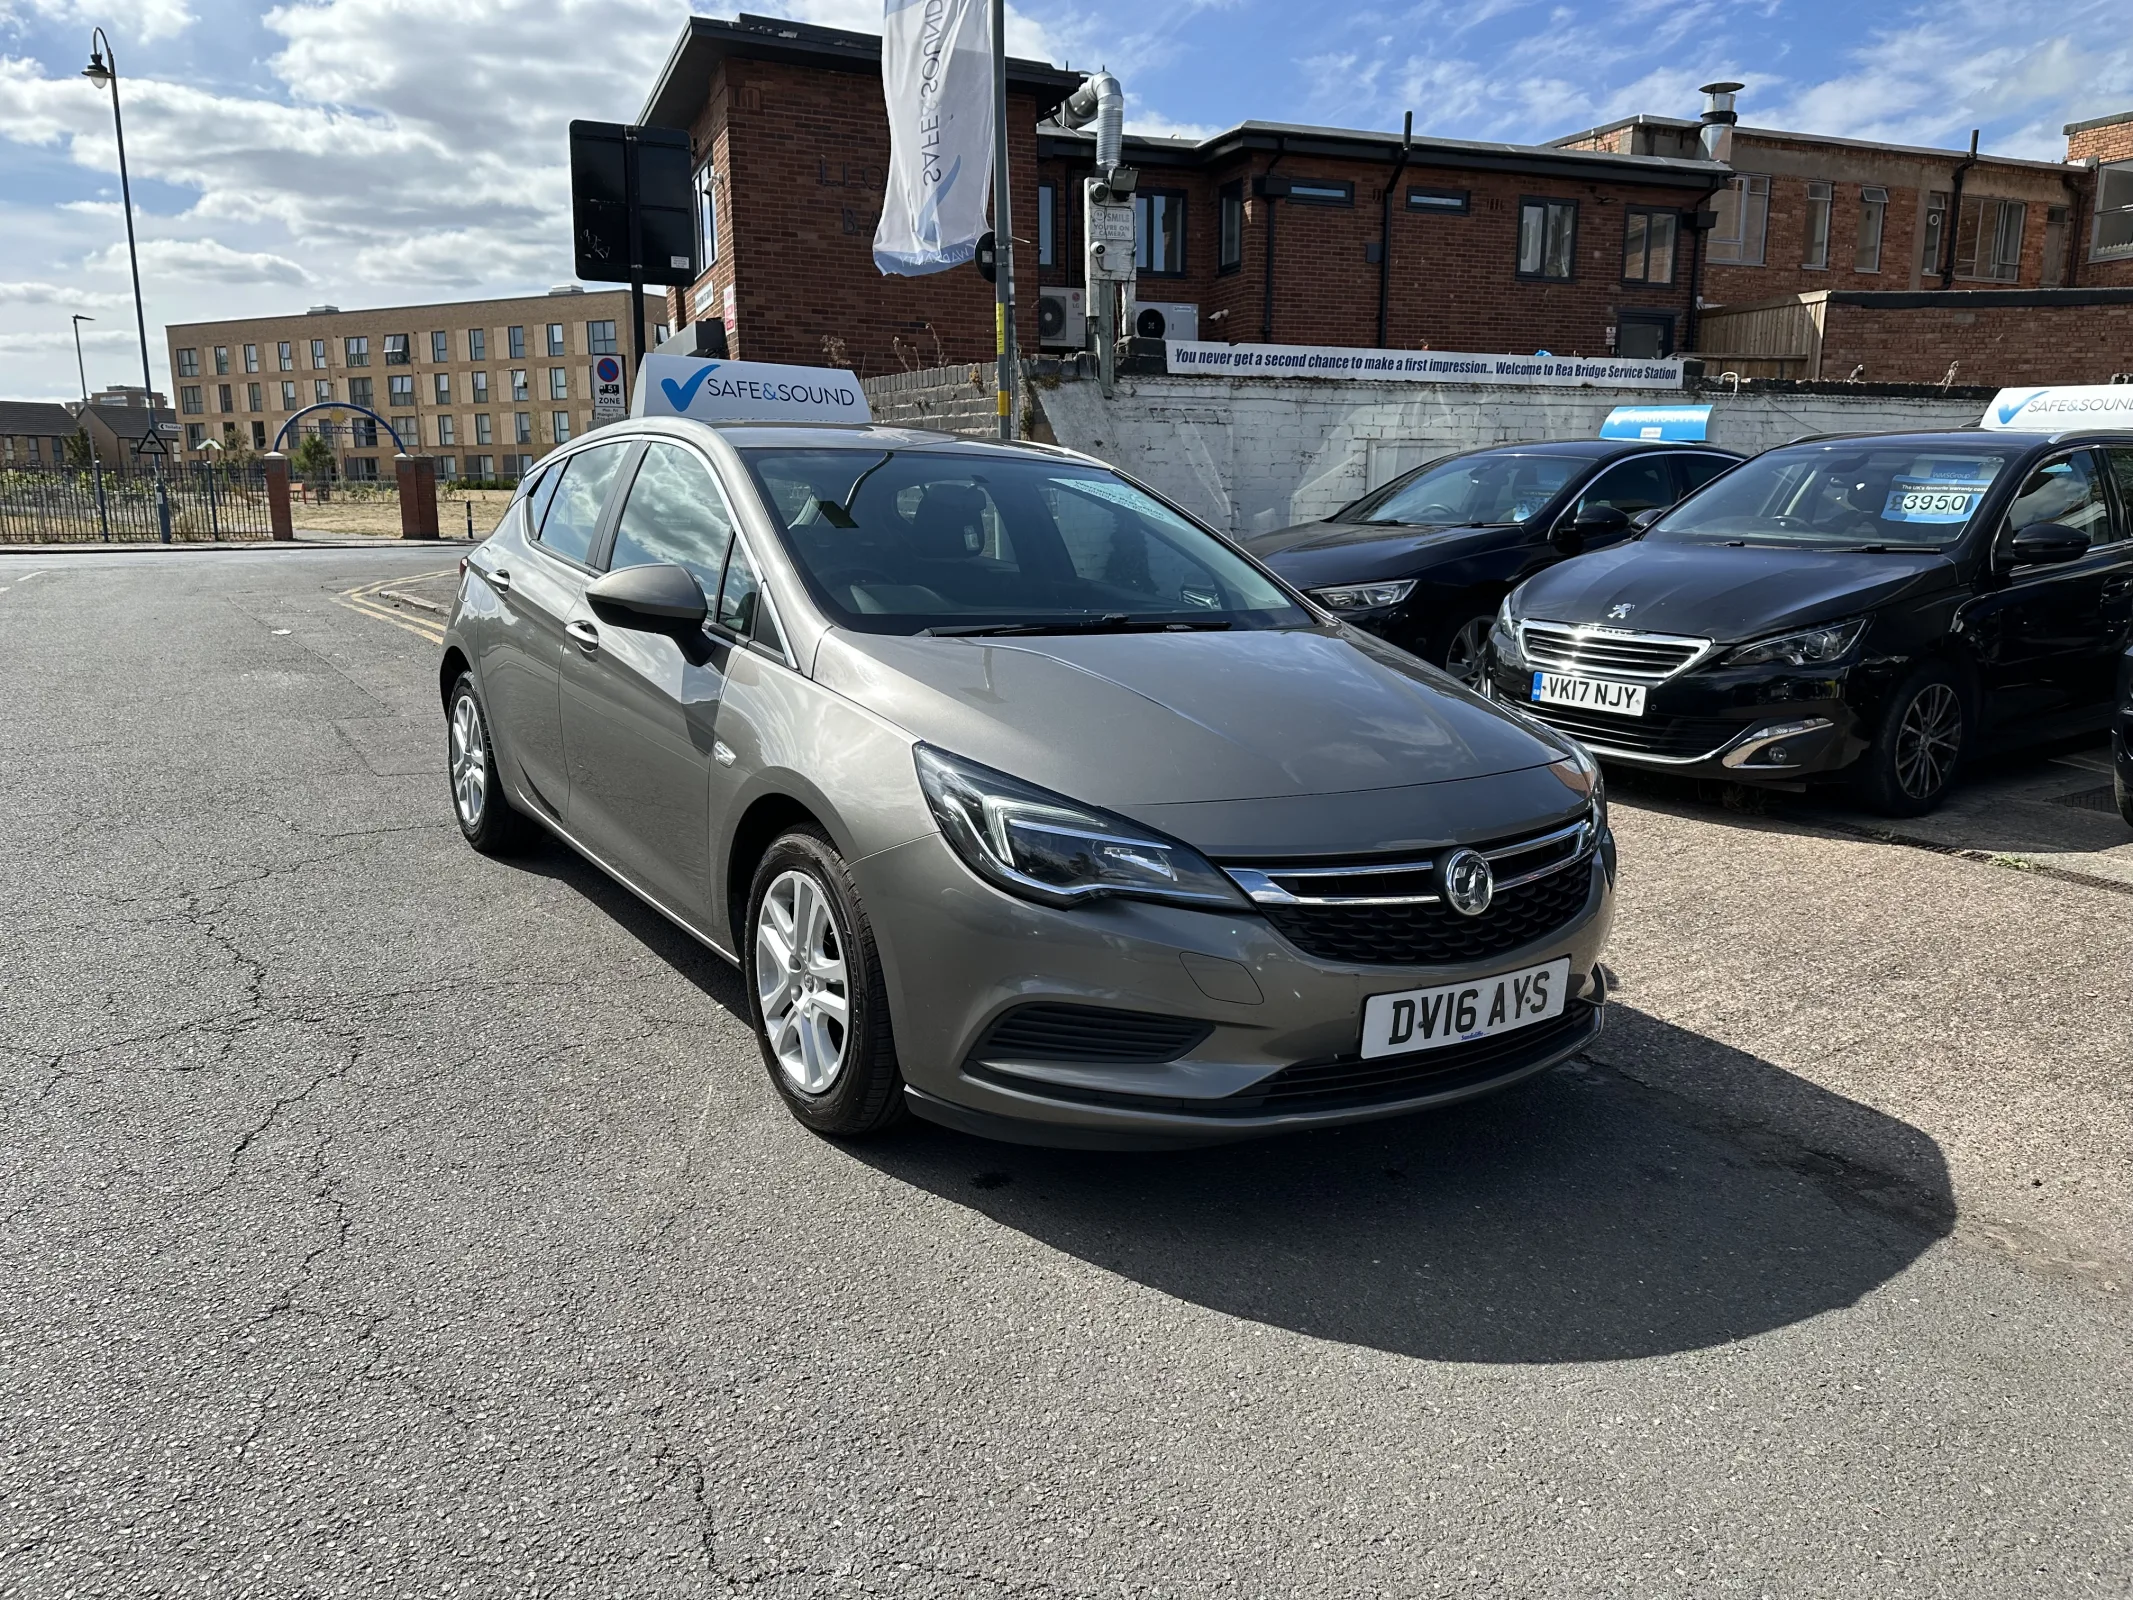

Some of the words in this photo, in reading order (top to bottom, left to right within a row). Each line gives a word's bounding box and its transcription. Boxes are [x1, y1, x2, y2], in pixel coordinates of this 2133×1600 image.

[819, 158, 886, 191] LLO
[1107, 213, 1130, 222] SMILE
[1175, 348, 1196, 363] You
[1198, 351, 1233, 365] never
[1234, 352, 1254, 367] get
[1255, 355, 1262, 366] a
[1264, 353, 1307, 367] second
[1307, 354, 1349, 369] chance
[1351, 356, 1363, 369] to
[1364, 357, 1394, 371] make
[1396, 360, 1402, 371] a
[1404, 358, 1428, 372] first
[1429, 358, 1494, 374] impression...
[1495, 361, 1542, 376] Welcome
[1543, 363, 1553, 376] to
[1555, 364, 1573, 376] Rea
[1575, 364, 1607, 378] Bridge
[1608, 365, 1643, 379] Service
[1644, 366, 1677, 380] Station
[707, 378, 855, 406] SAFE&SOUND
[1933, 471, 1971, 479] WMSGroup
[1549, 676, 1590, 702] VK17
[1594, 683, 1637, 709] NJY
[1388, 988, 1479, 1046] DV16
[1487, 970, 1550, 1027] AYS
